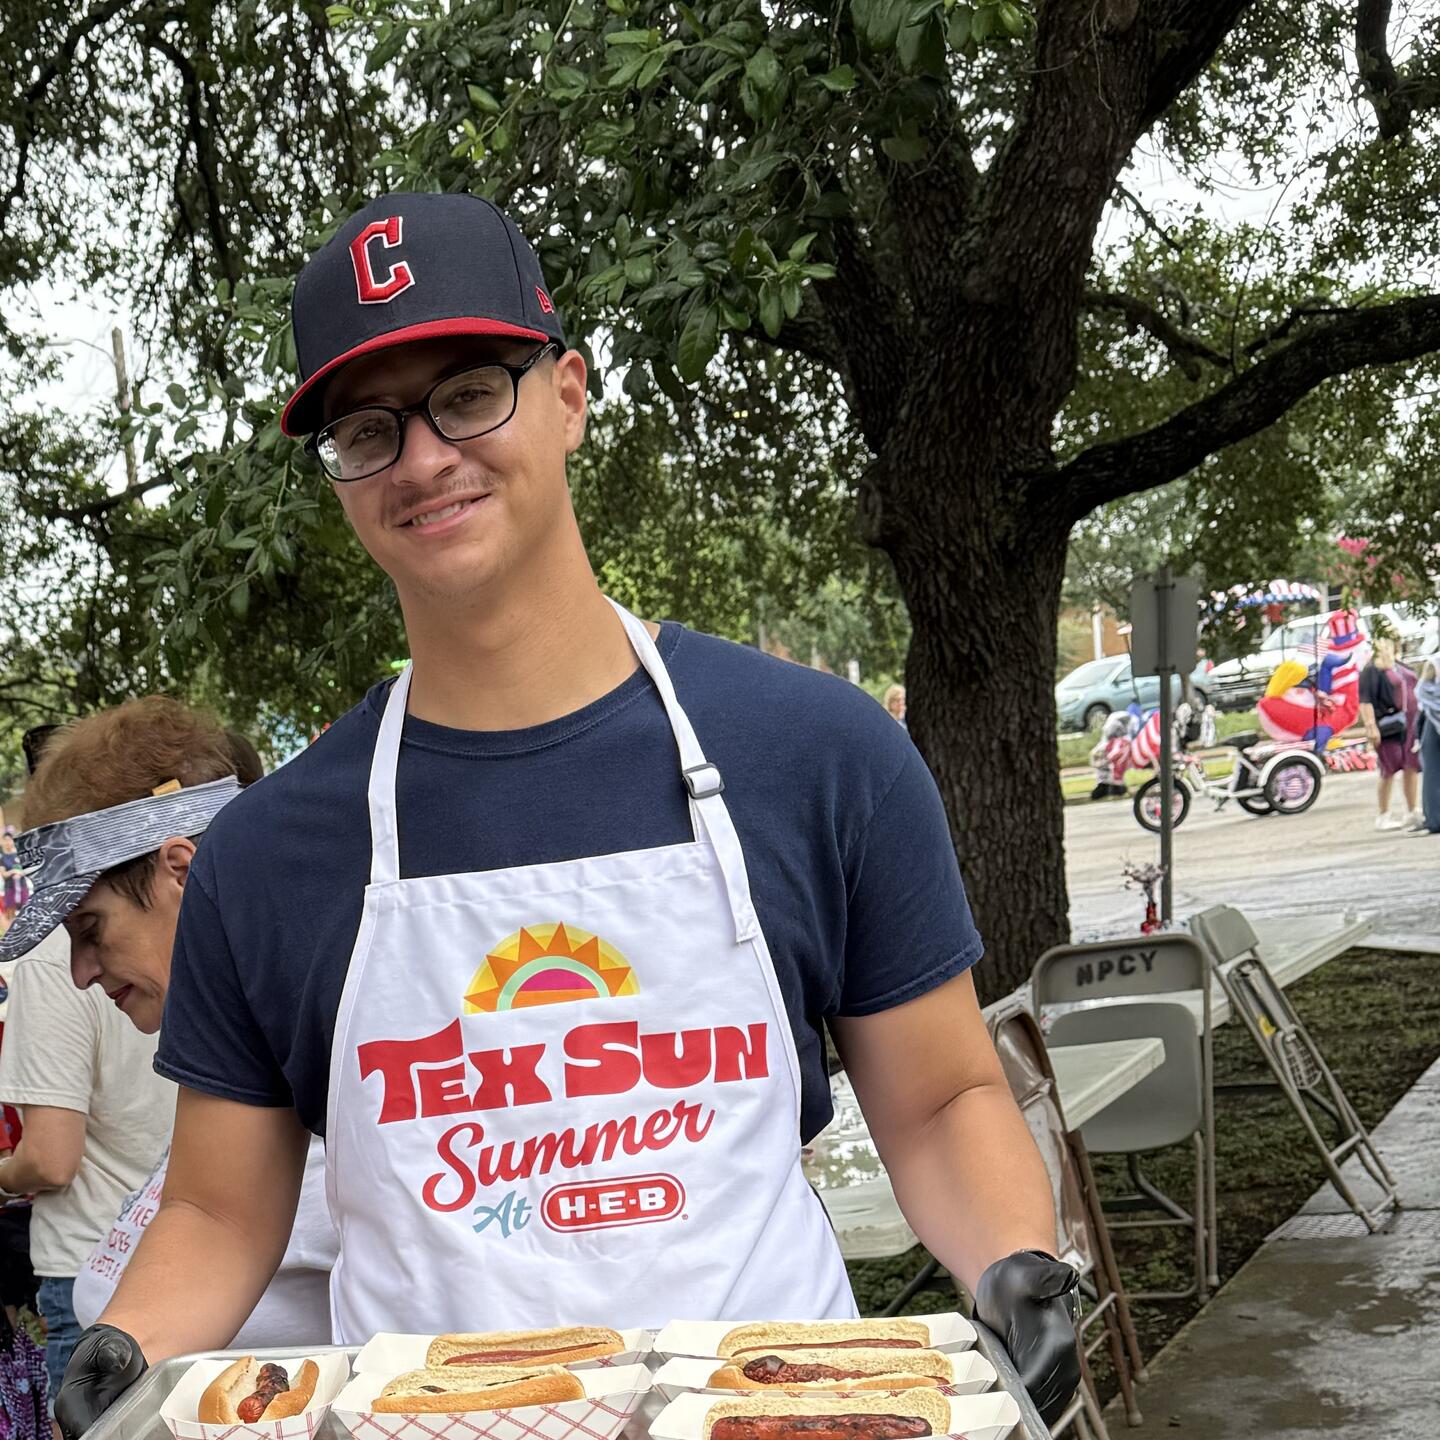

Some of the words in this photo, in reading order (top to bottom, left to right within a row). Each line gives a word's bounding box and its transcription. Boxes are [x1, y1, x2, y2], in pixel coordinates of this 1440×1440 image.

[349, 216, 415, 304] C
[1076, 949, 1157, 987] NPCY
[357, 1018, 552, 1124] TEX
[564, 1021, 769, 1098] SUN
[422, 1100, 715, 1212] Summer
[472, 1190, 532, 1238] At
[558, 1186, 666, 1220] H-E-B
